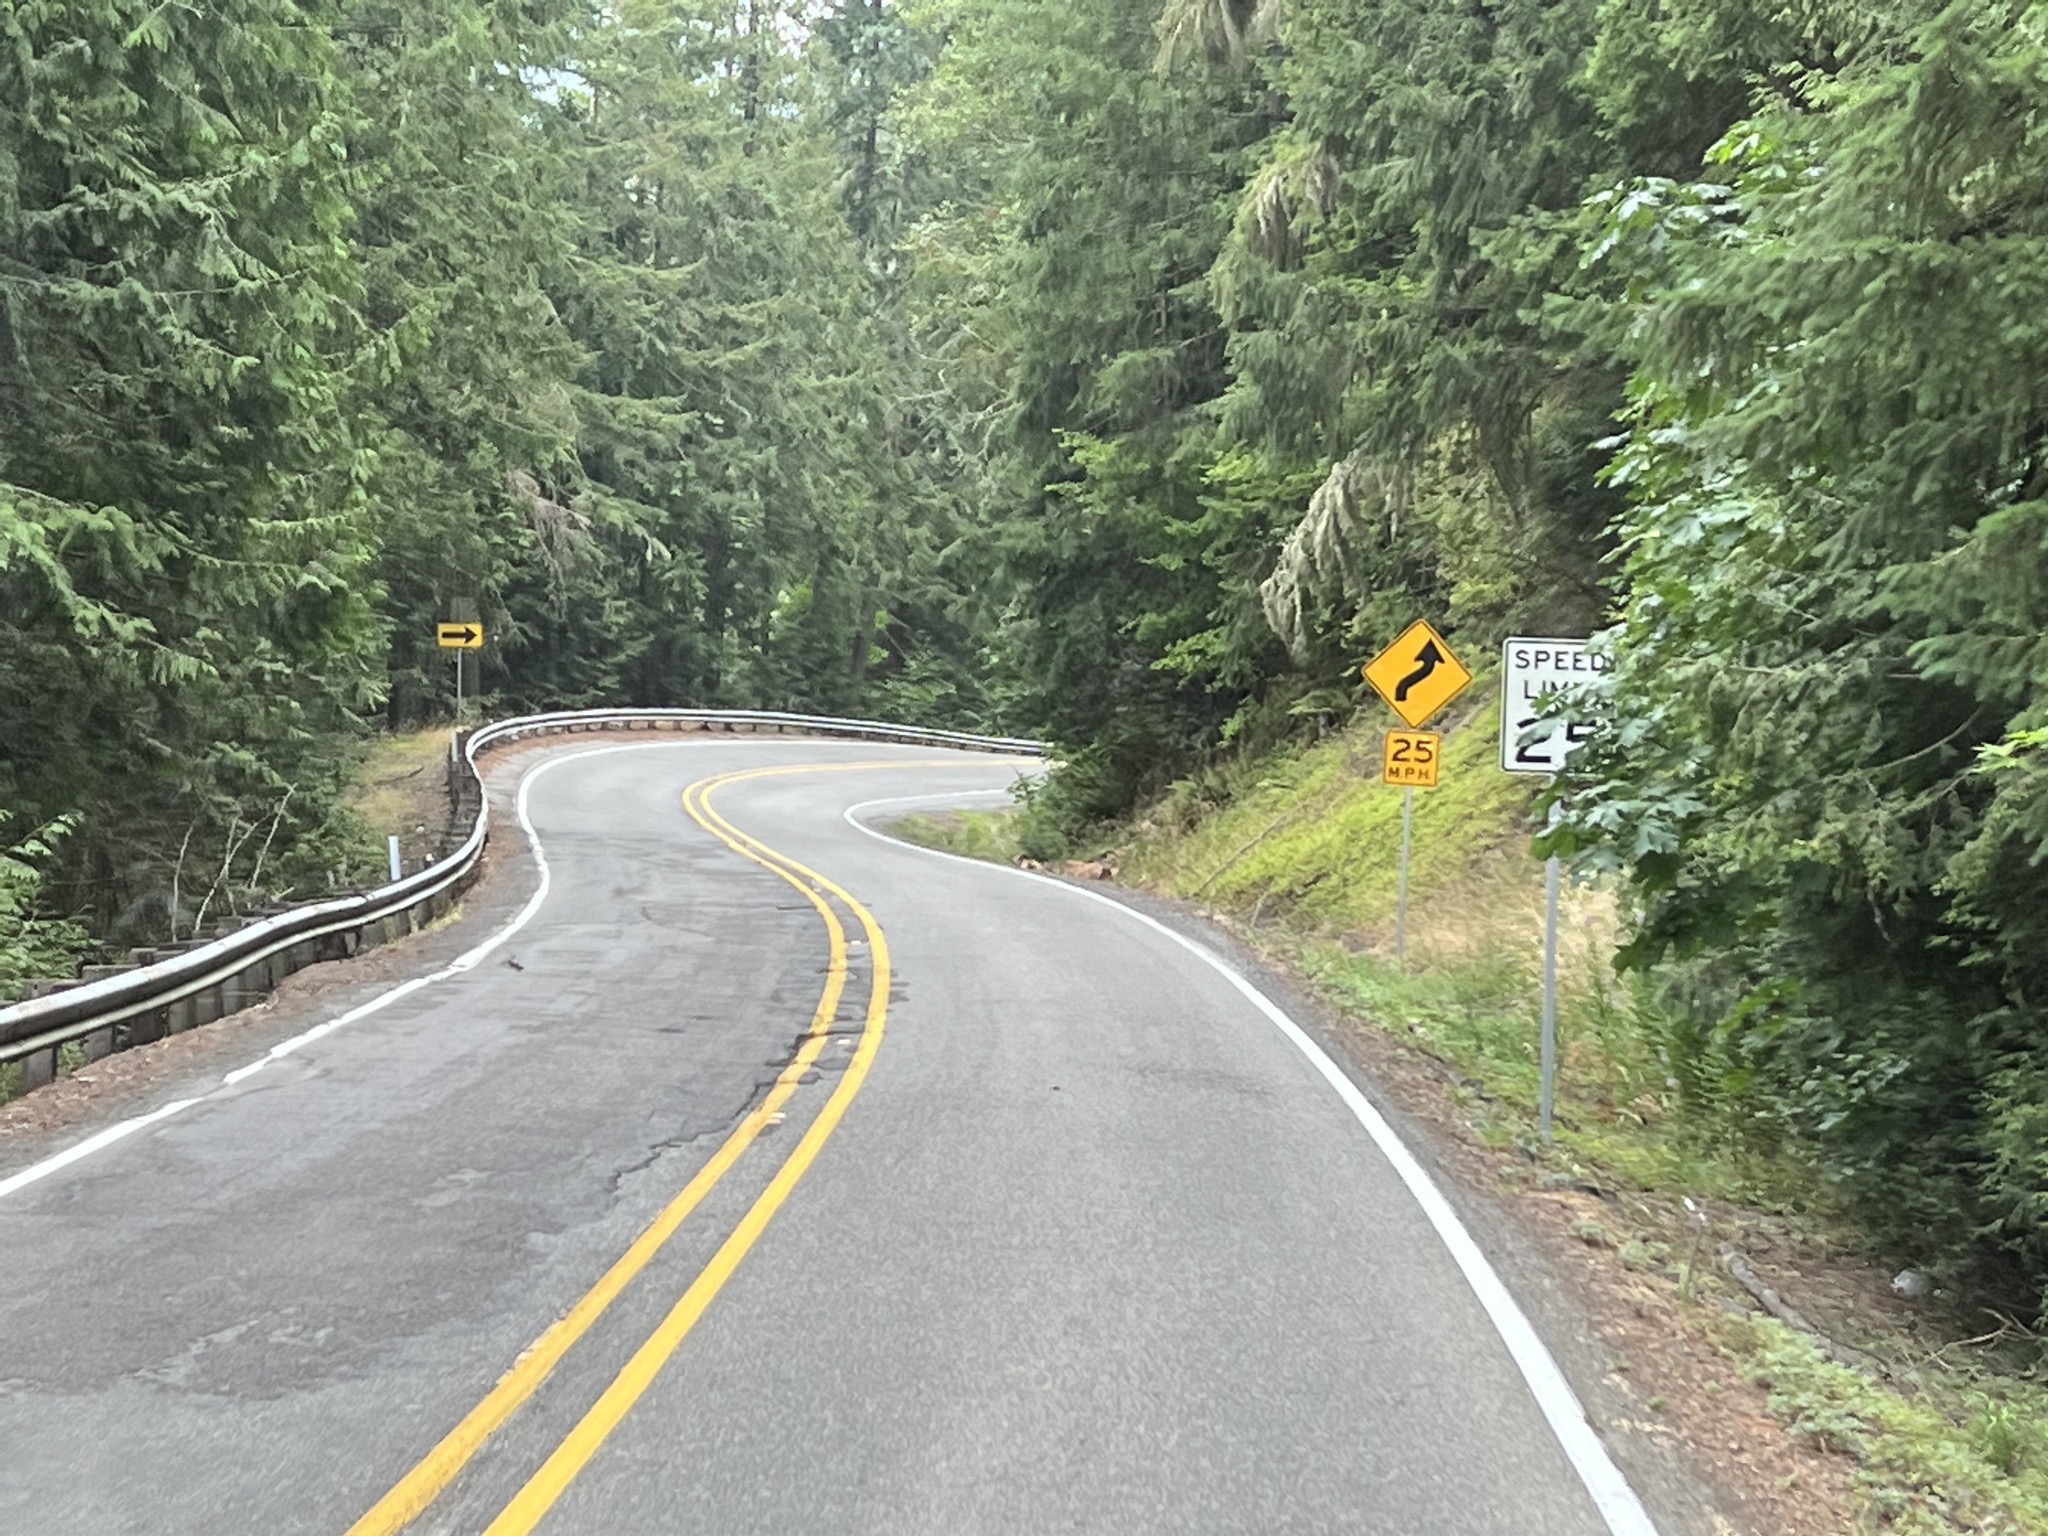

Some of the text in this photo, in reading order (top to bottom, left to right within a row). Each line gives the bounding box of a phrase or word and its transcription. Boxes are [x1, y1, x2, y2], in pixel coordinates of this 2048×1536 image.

[1515, 650, 1606, 671] SPEED
[1523, 680, 1571, 699] LIM
[1392, 738, 1433, 763] 25
